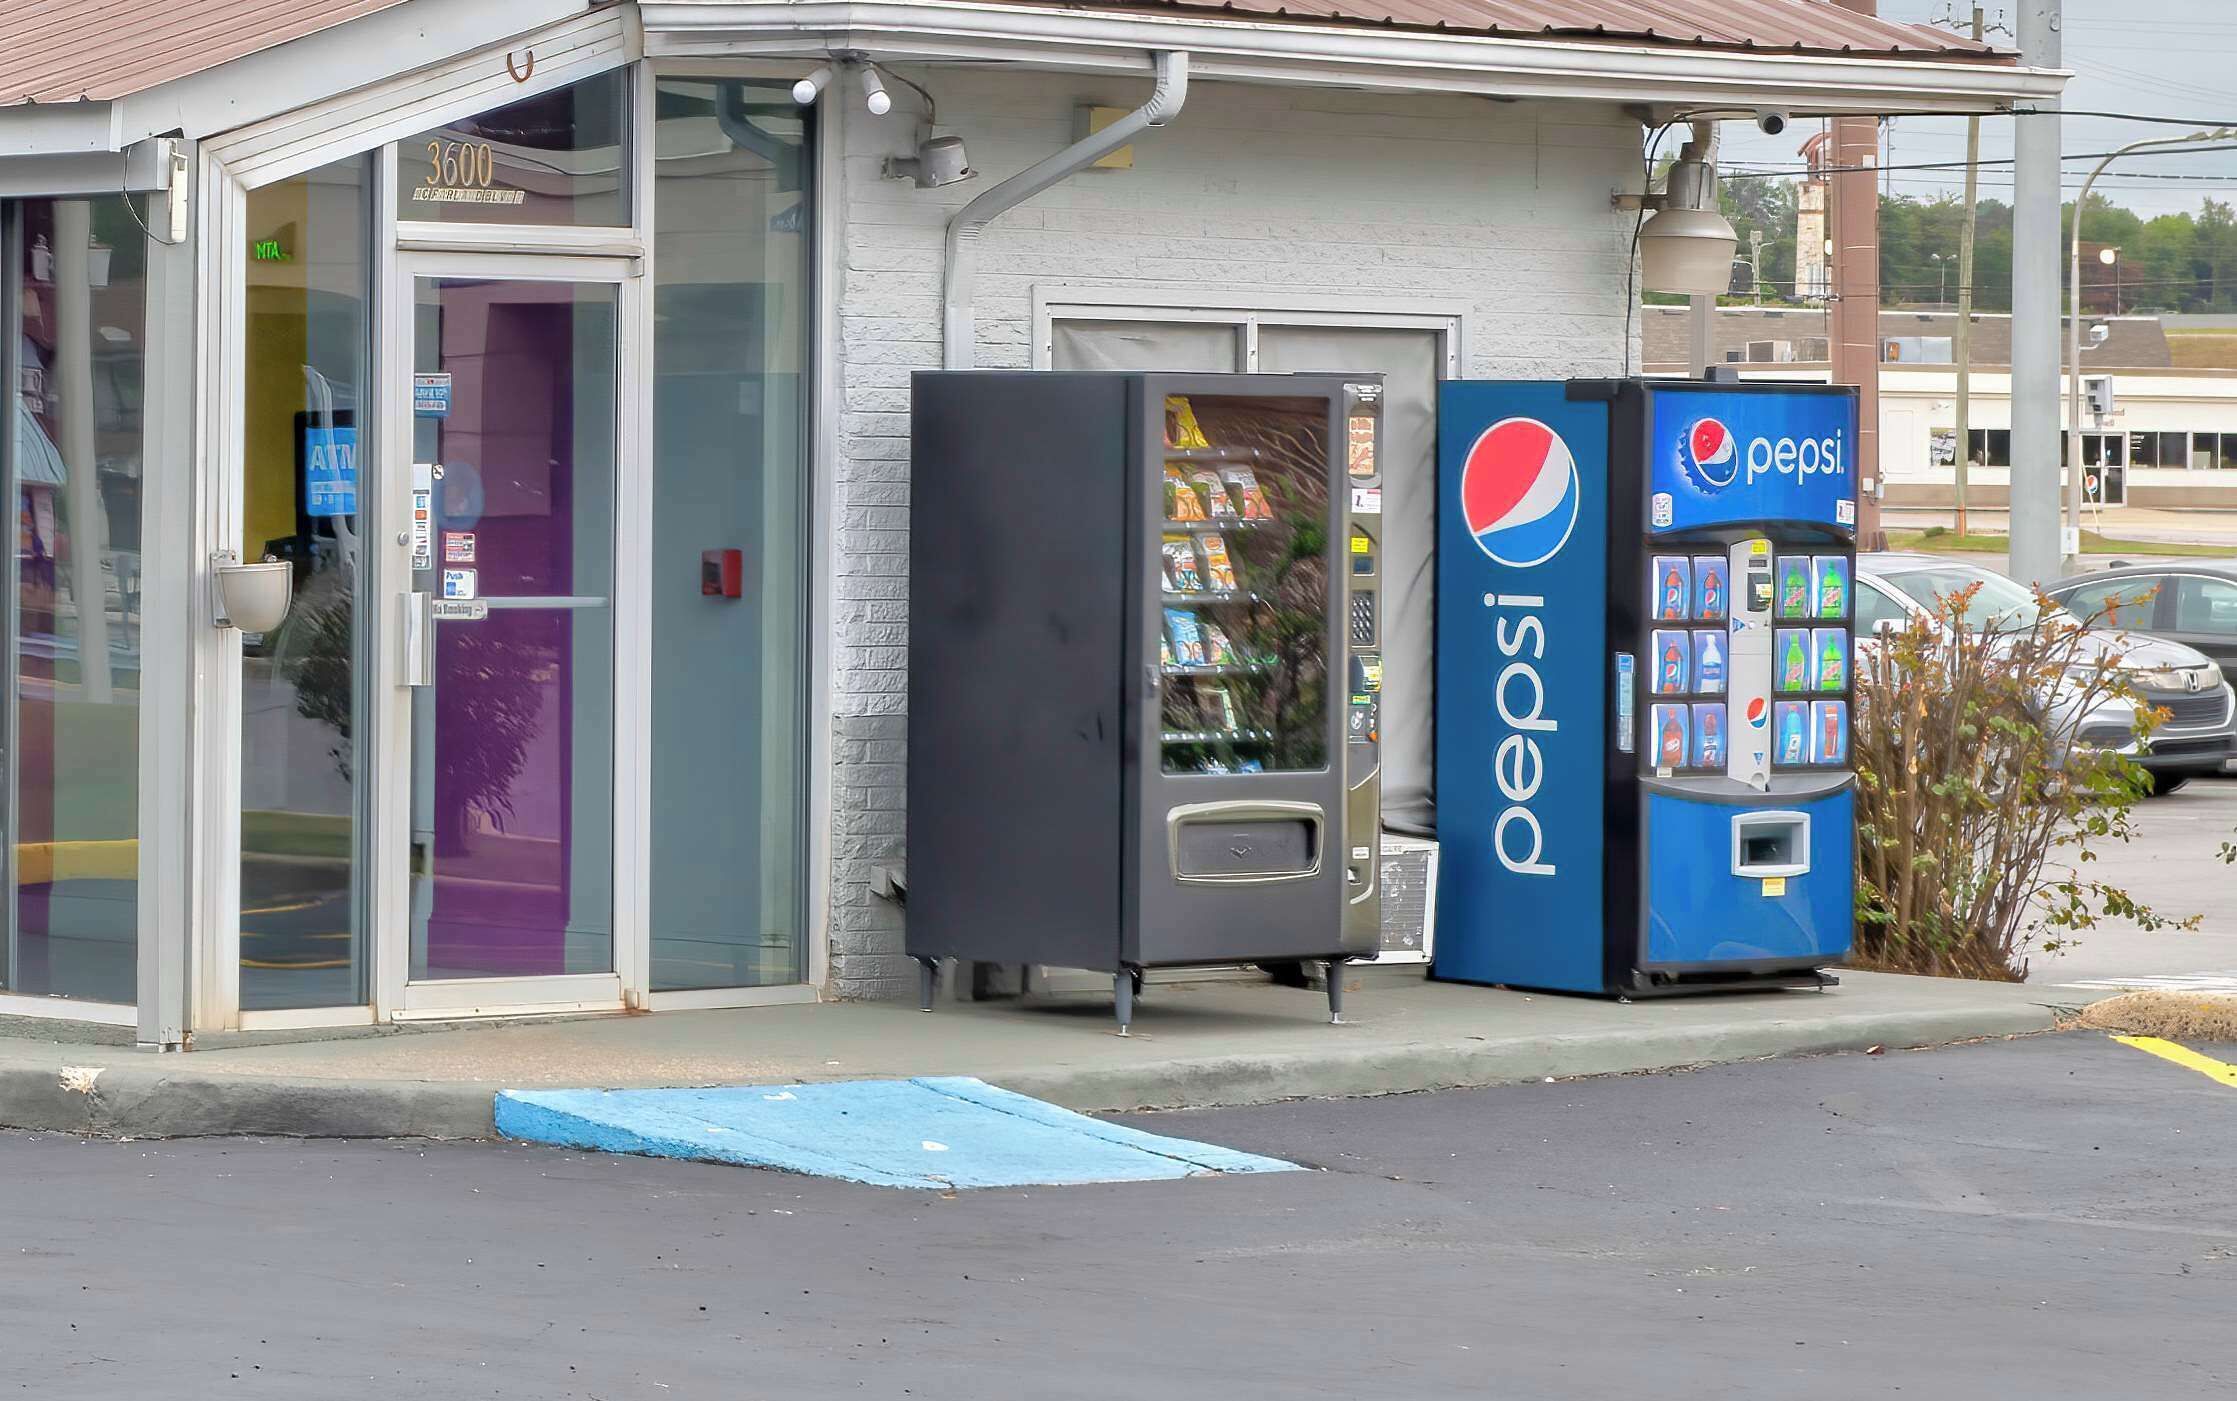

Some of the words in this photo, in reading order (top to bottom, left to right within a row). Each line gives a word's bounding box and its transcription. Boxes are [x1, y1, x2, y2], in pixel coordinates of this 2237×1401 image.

[426, 141, 492, 187] 3600
[1747, 428, 1842, 485] pepsi
[1483, 592, 1558, 876] pepsi
